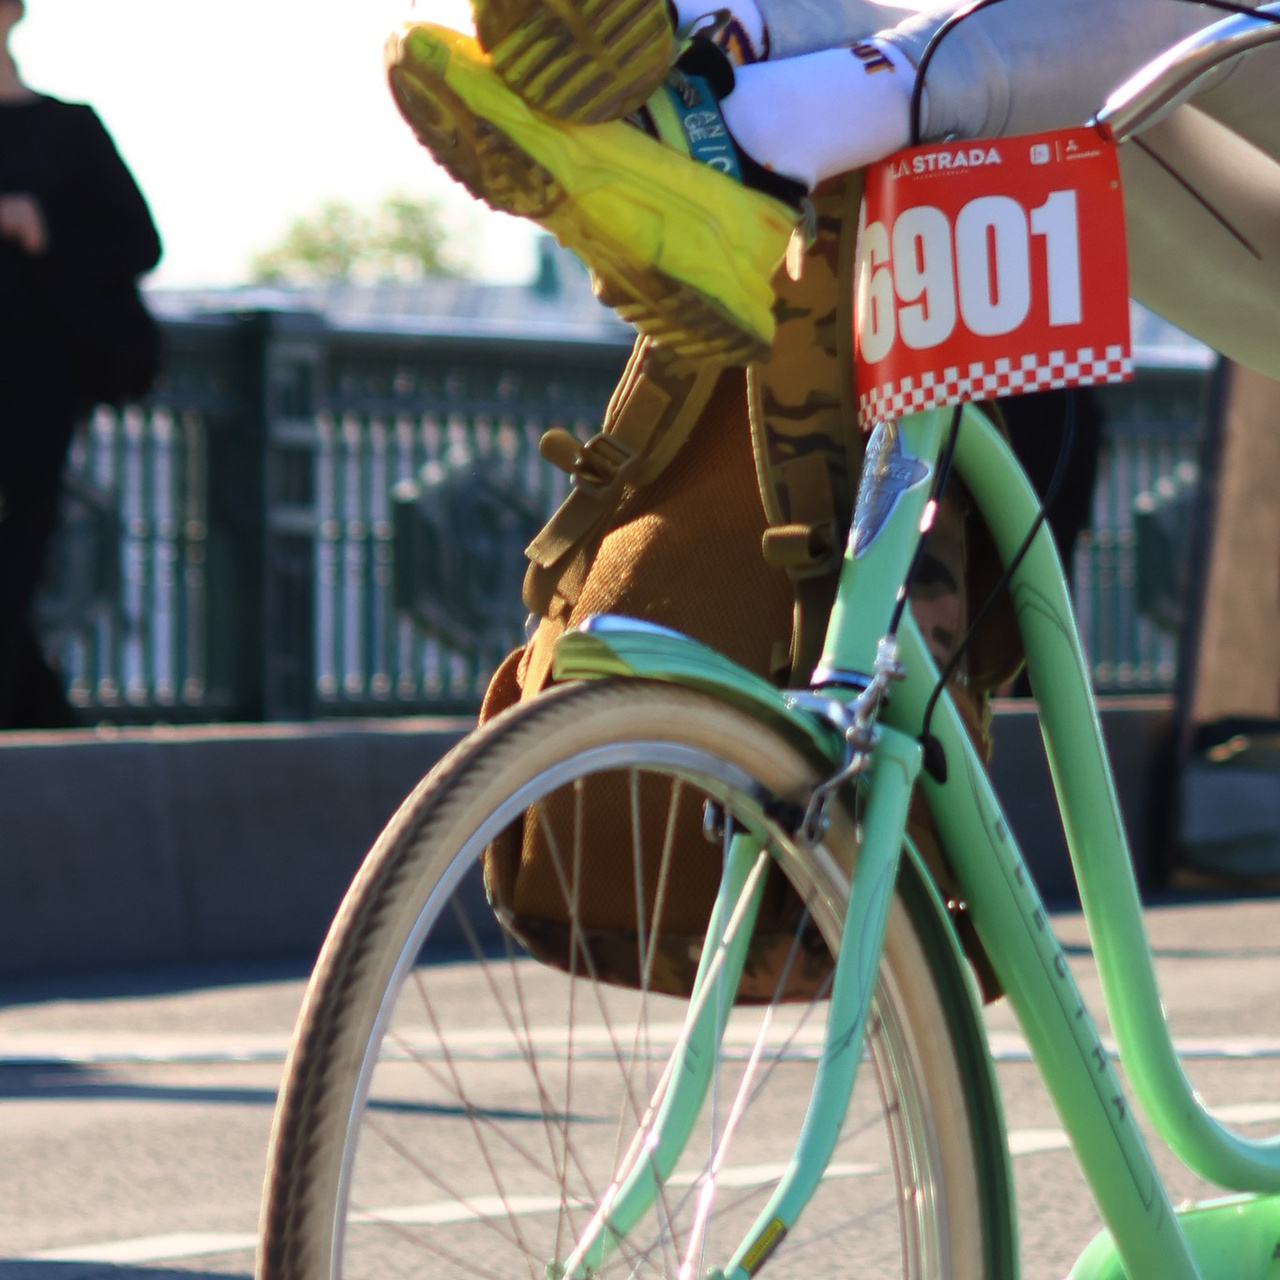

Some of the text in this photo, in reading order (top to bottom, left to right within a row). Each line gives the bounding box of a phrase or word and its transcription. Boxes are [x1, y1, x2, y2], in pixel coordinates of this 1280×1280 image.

[889, 158, 910, 181] LA
[912, 147, 1002, 174] STRADA
[857, 189, 1082, 364] 6901
